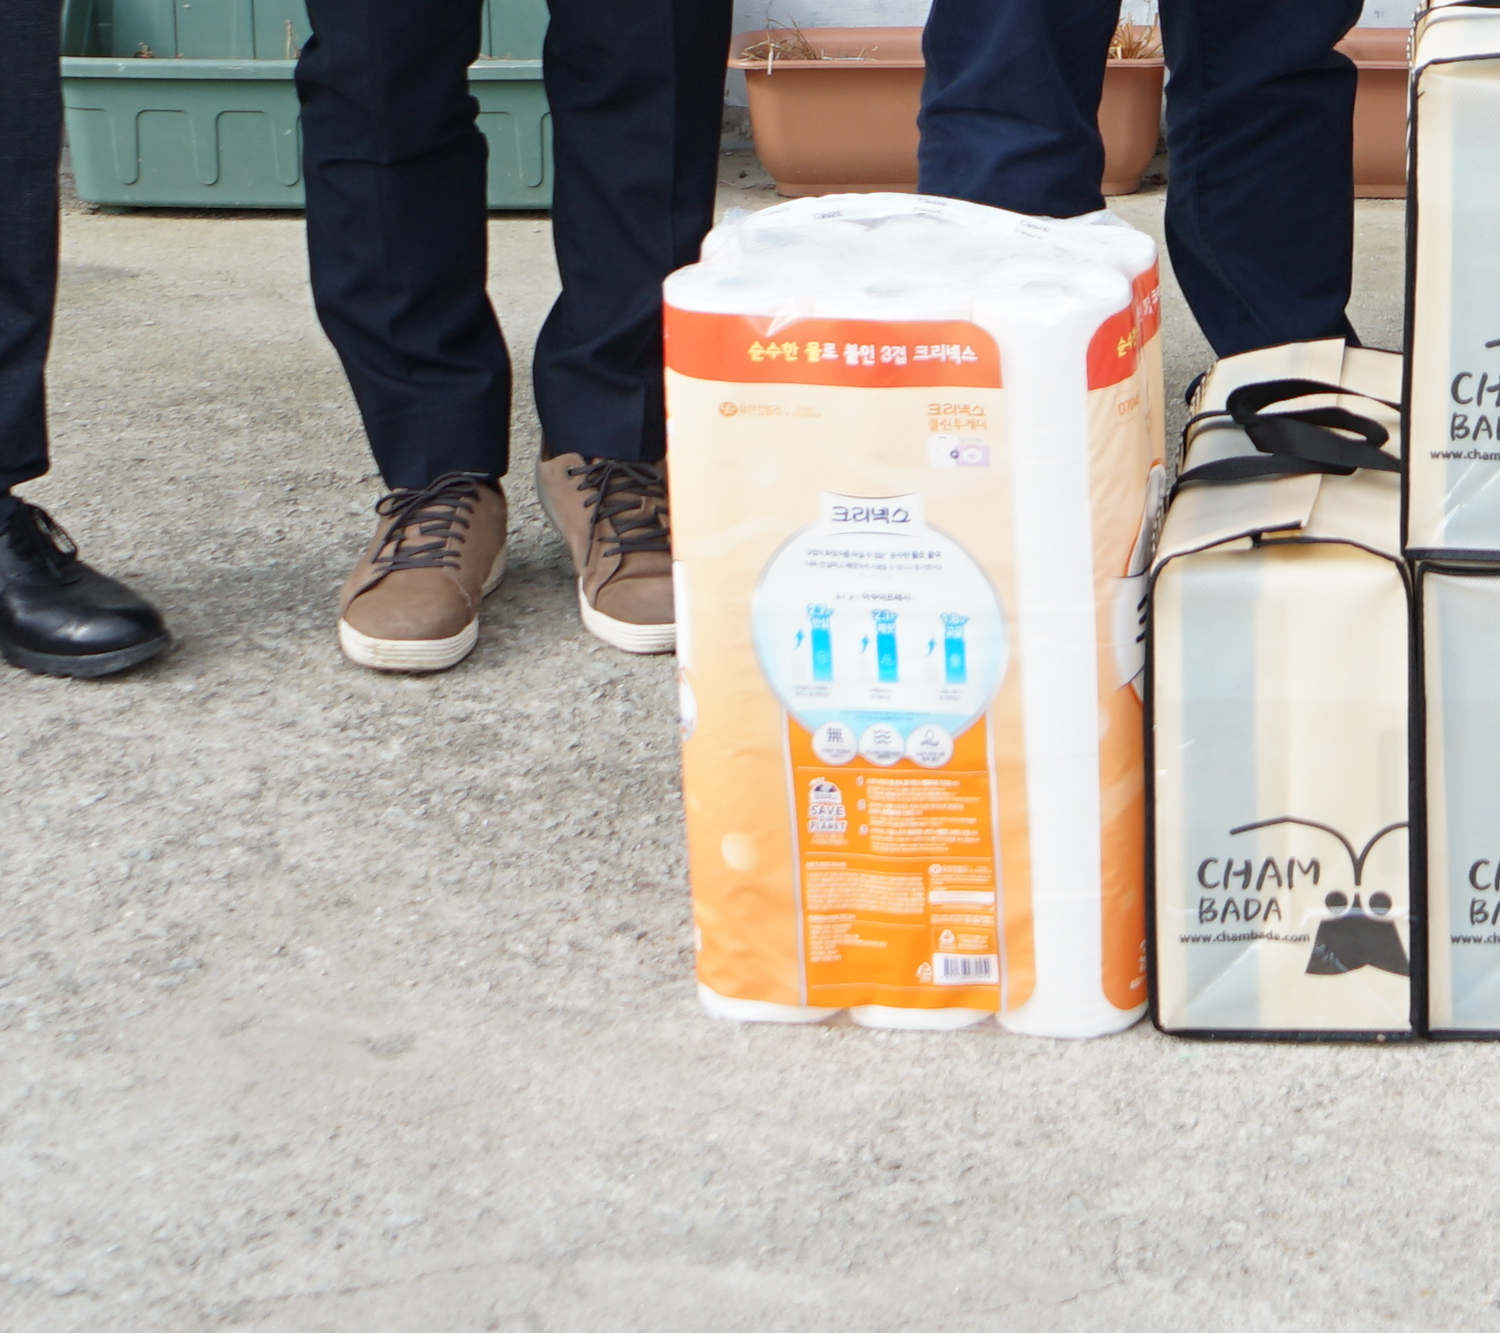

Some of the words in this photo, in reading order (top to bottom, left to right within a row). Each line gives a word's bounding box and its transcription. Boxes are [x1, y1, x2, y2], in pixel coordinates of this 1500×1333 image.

[748, 340, 799, 362] 순수한
[804, 341, 839, 362] 물로
[880, 344, 907, 366] 3겹
[912, 343, 978, 365] 크리넥스
[927, 403, 986, 416] 크리넥스
[832, 505, 913, 524] 크리넥스
[811, 804, 845, 816] SAVE
[1197, 856, 1322, 889] CHAM
[1198, 897, 1283, 925] BADA
[1179, 930, 1312, 944] www.chambada.com
